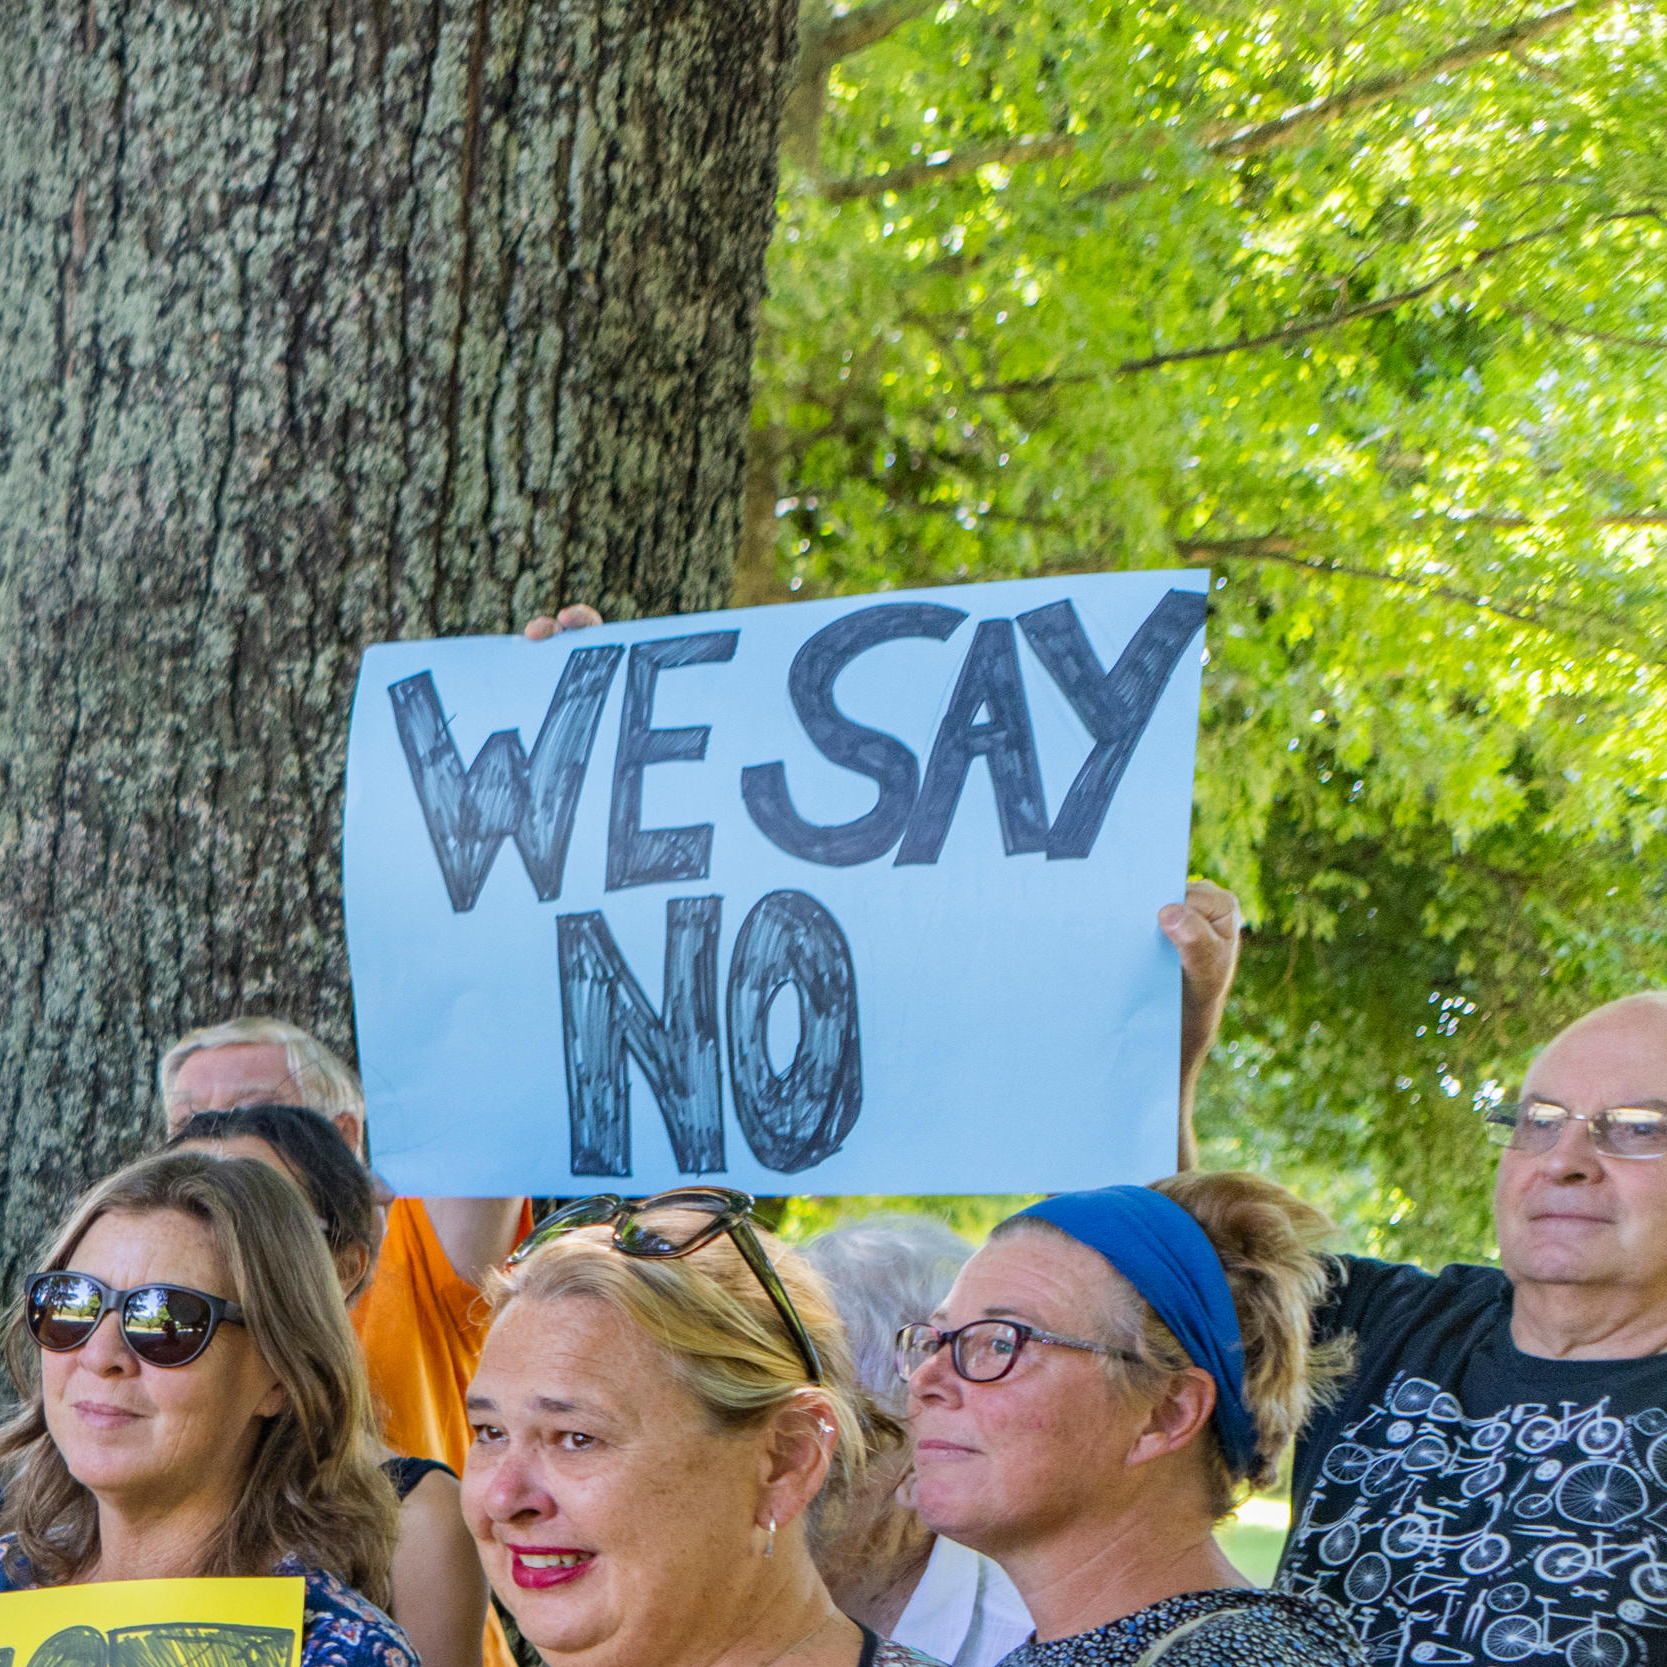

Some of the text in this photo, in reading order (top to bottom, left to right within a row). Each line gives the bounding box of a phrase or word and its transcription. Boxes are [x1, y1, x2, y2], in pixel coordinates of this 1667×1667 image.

[387, 588, 1208, 913] WE SAY
[556, 889, 863, 1177] NO
